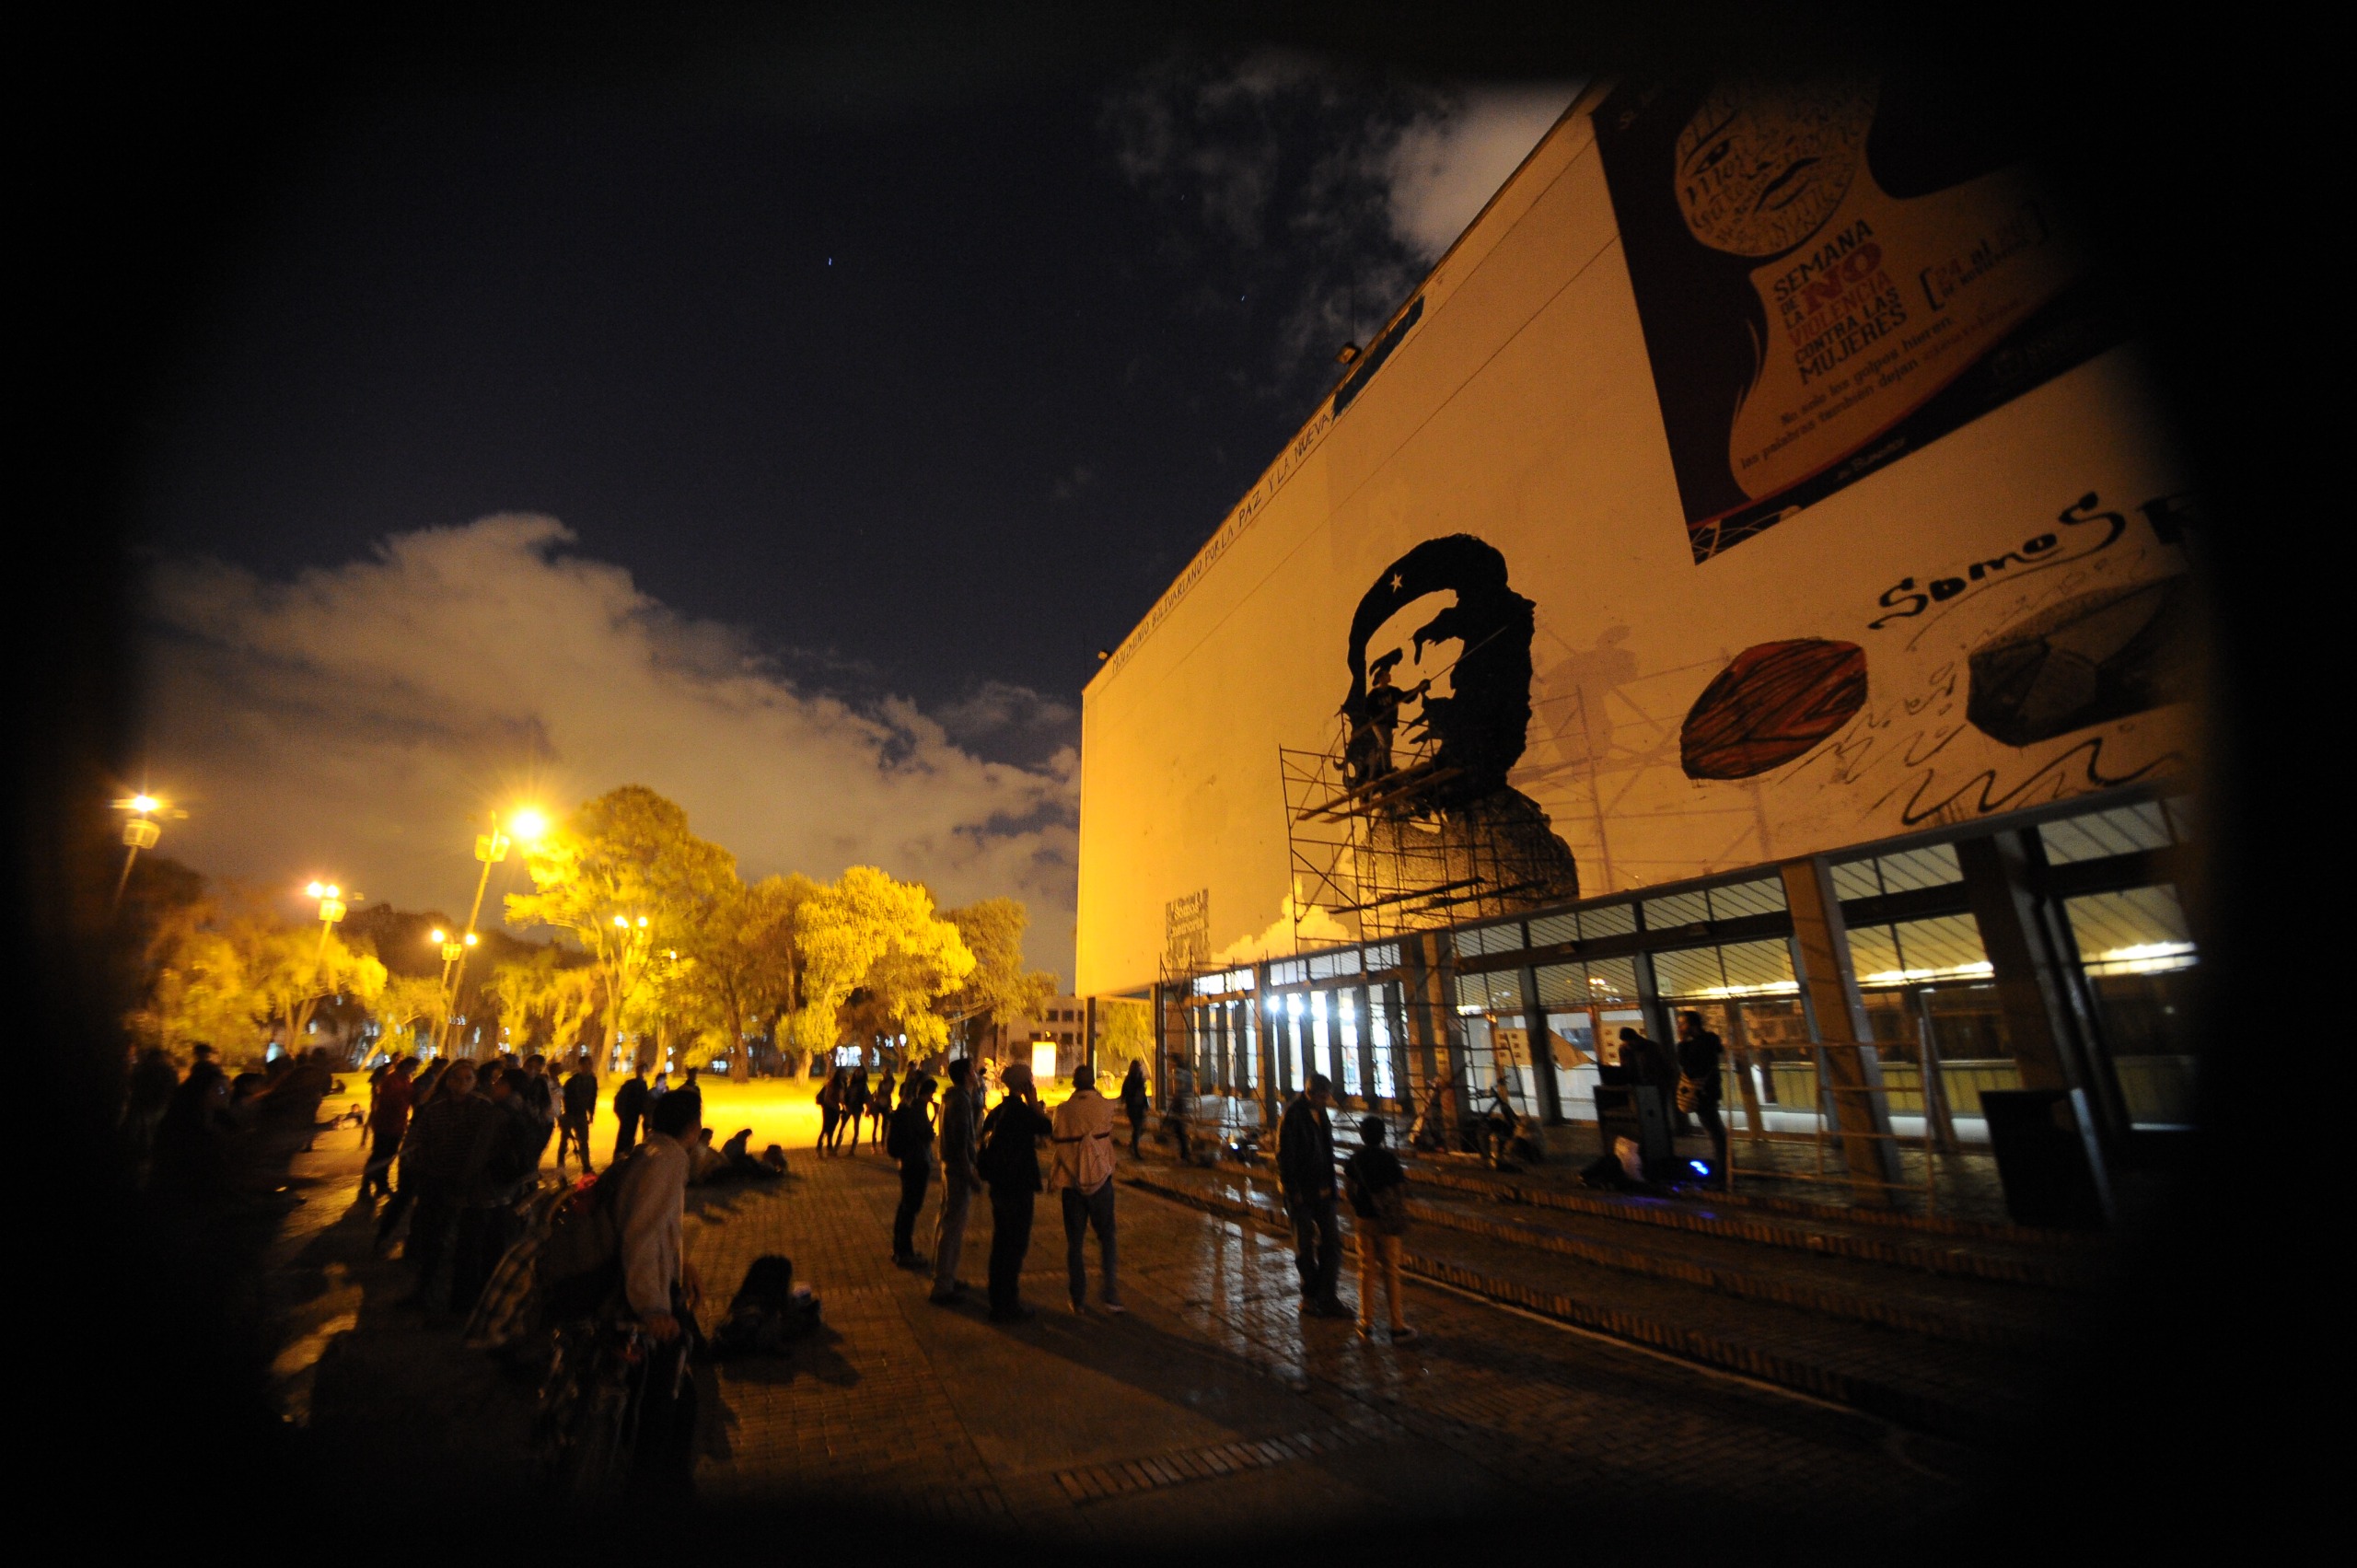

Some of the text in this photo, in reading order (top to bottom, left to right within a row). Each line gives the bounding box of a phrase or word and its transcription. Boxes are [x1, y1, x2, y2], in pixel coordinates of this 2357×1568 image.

[1774, 219, 1873, 301] SEMANA
[1802, 242, 1882, 315] NO
[1782, 296, 1801, 316] DE
[1785, 310, 1805, 330] LA
[1790, 271, 1891, 346] VIOLENCIA
[1796, 286, 1902, 364] CONTRA LAS
[1799, 308, 1907, 385] MUJERES
[1853, 348, 1899, 385] golpes
[1740, 453, 1759, 470] las
[1762, 420, 1816, 460] palabras
[1879, 357, 1920, 389] dejan
[1204, 540, 1219, 568] POR
[1221, 525, 1234, 549] LA
[1238, 490, 1262, 528] PAZ
[1268, 474, 1274, 493] Y
[1277, 457, 1290, 484] LA
[1294, 413, 1330, 462] NUEVA
